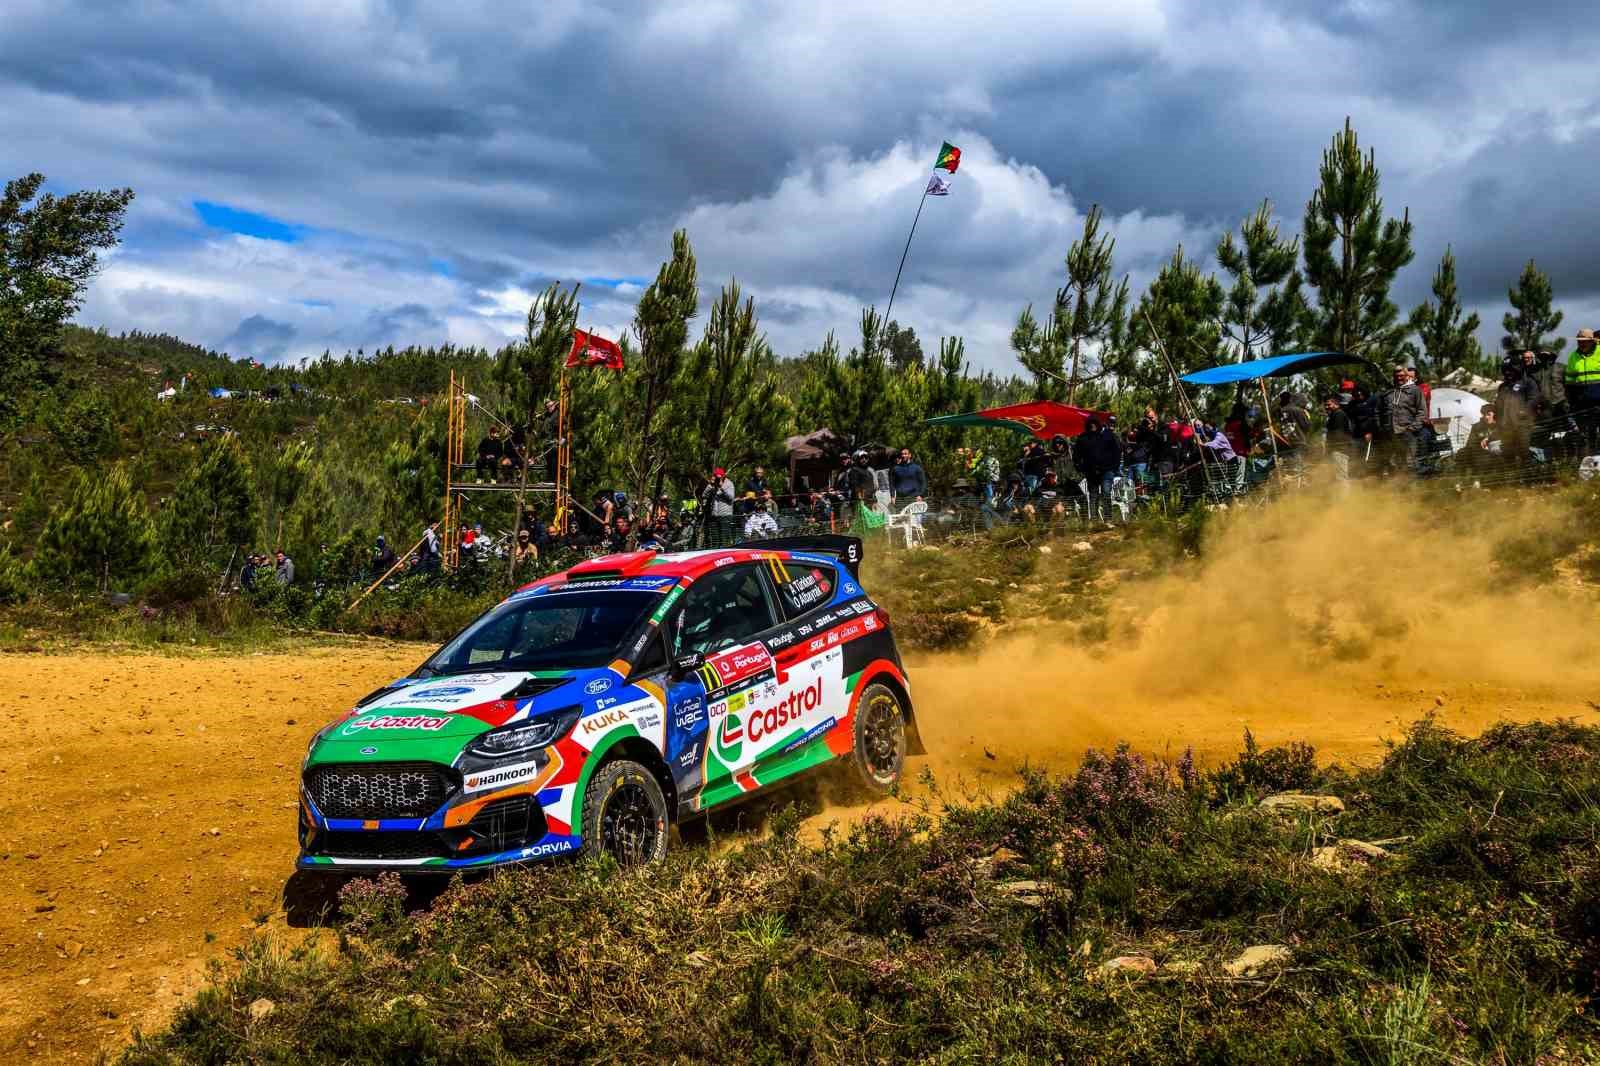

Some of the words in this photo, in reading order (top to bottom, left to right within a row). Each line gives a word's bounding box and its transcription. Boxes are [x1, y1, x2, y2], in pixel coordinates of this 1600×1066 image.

[735, 652, 769, 669] Portugal
[748, 676, 822, 742] Castrol
[368, 715, 453, 731] Castrol
[582, 709, 630, 734] KUKA
[523, 841, 572, 857] FORVIA
